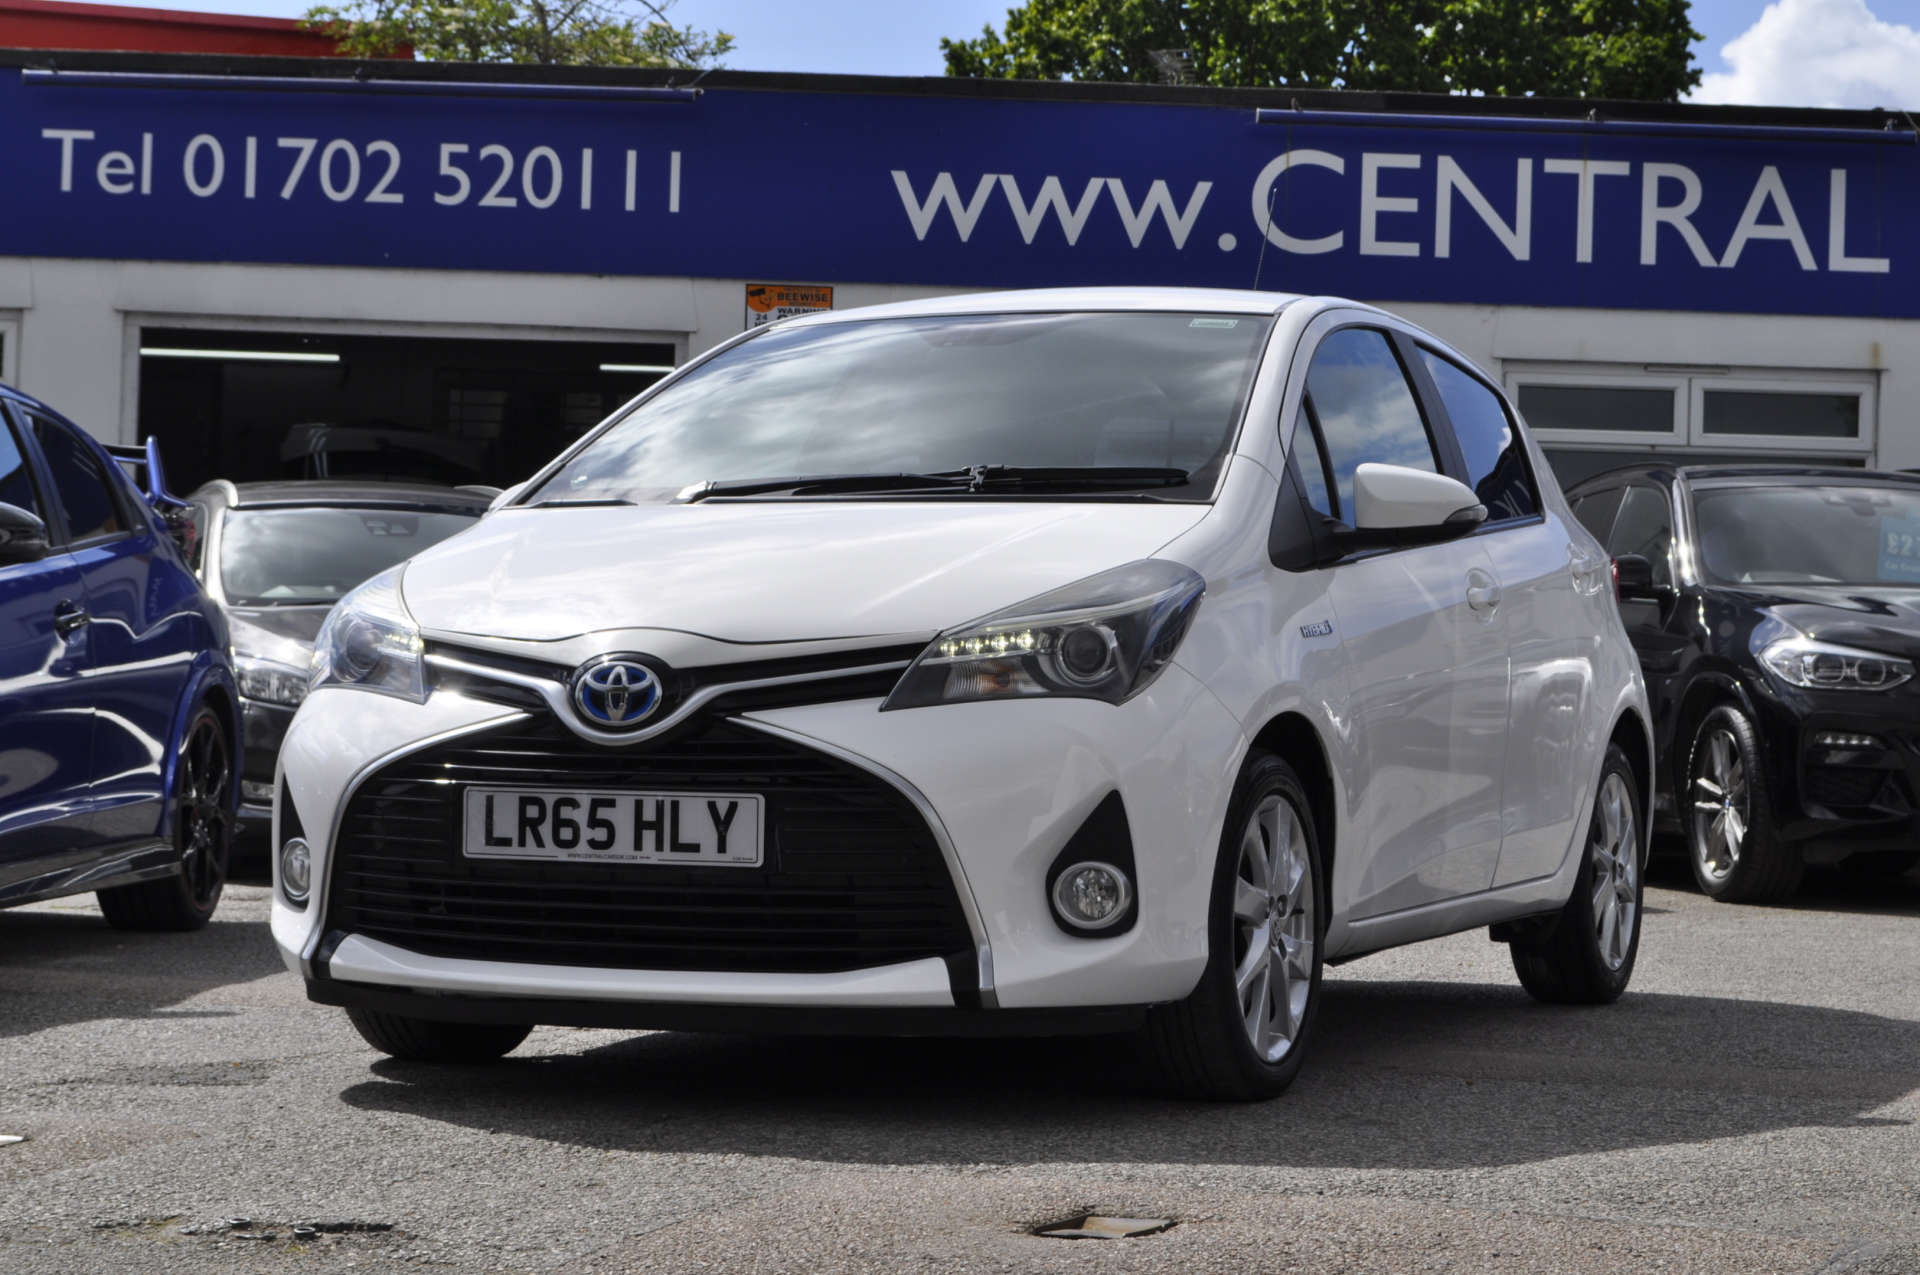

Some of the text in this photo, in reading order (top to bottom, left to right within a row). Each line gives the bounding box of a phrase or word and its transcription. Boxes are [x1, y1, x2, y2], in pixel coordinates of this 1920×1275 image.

[41, 128, 681, 213] Tel 01702 520111
[890, 149, 1891, 273] www.CENTRAL
[777, 293, 828, 303] BEEWISE
[484, 794, 739, 854] LR65 HLY
